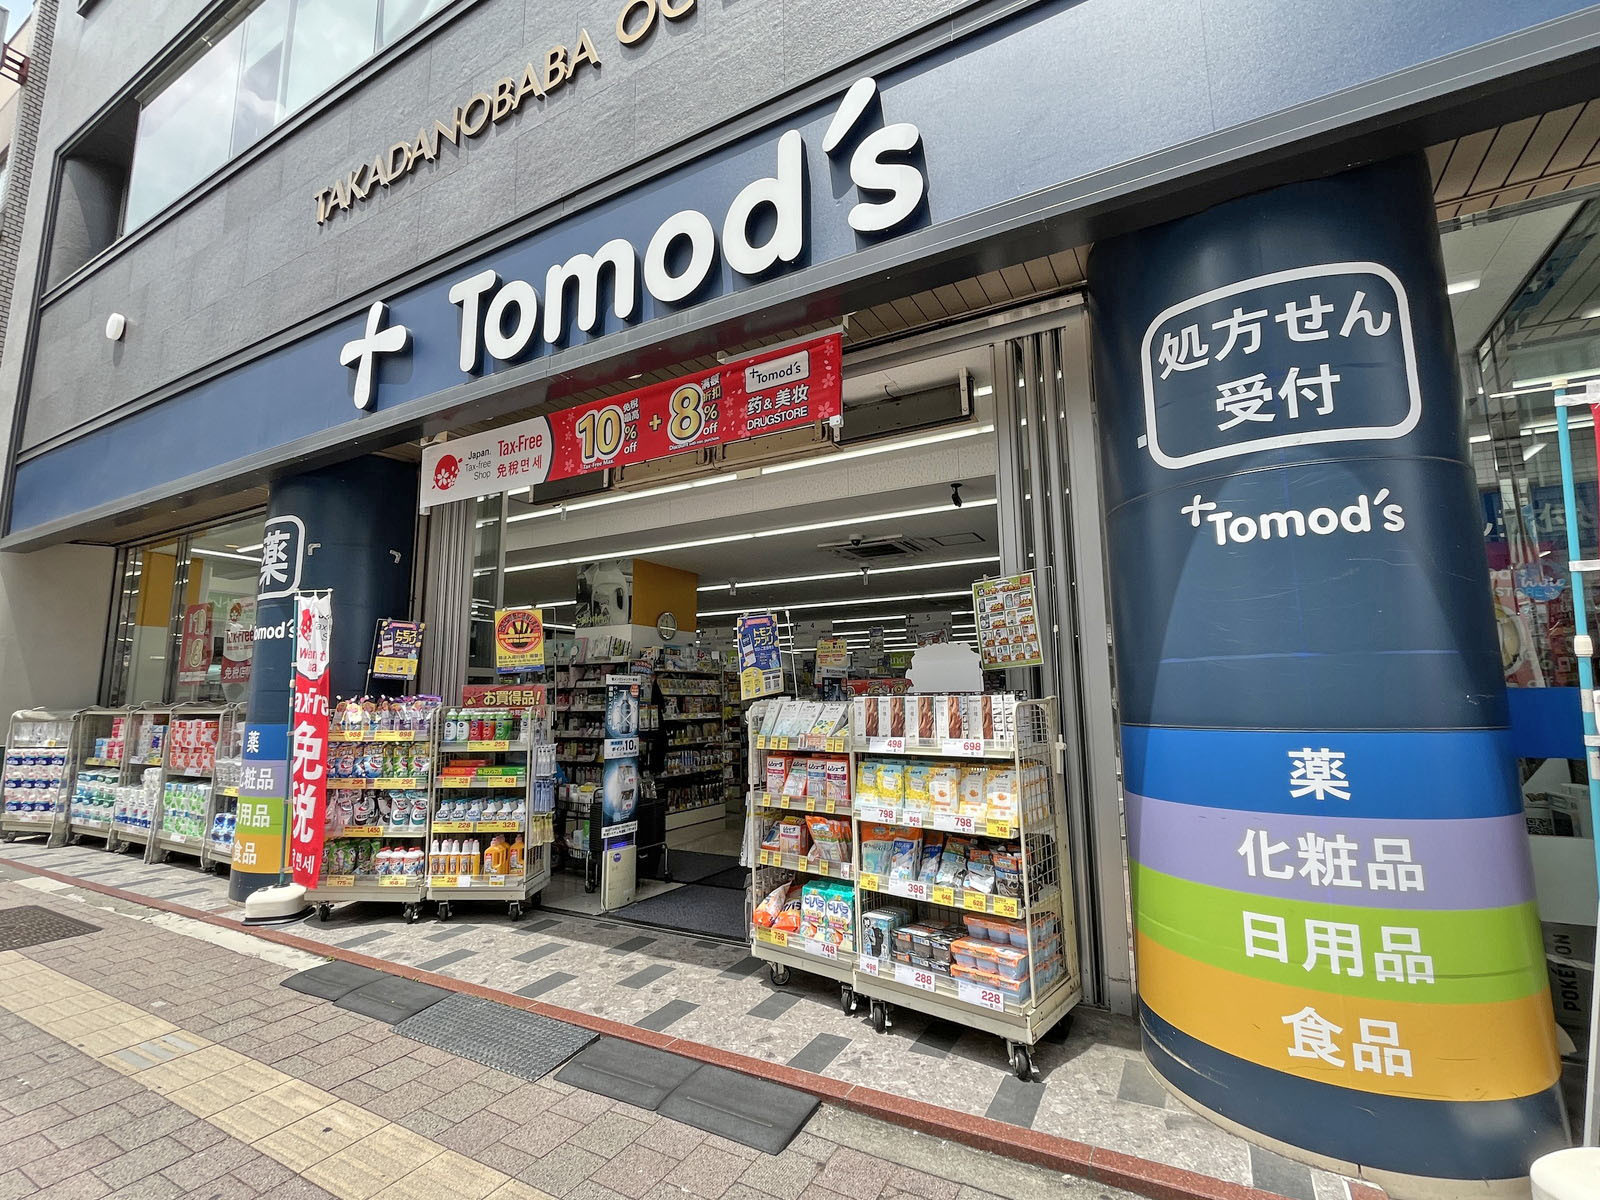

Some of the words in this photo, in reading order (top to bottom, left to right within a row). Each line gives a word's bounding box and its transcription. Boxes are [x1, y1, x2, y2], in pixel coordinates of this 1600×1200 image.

[314, 28, 600, 225] TAKADANOBABA
[449, 76, 925, 375] Tomod's
[1158, 290, 1392, 380] 処方せん
[756, 364, 801, 384] Tomod's
[1215, 363, 1341, 431] 受付
[575, 405, 625, 464] 10
[623, 441, 638, 454] off
[667, 382, 705, 446] 8
[703, 421, 719, 436] off
[747, 406, 809, 431] DRUGSTORE
[498, 434, 542, 457] Tax-Free
[465, 460, 492, 472] Tax-free
[474, 470, 491, 480] Shop
[1207, 488, 1406, 546] Tomod's
[483, 690, 541, 706] お買得品!
[246, 731, 260, 753] 薬
[887, 740, 902, 749] 498
[963, 742, 981, 751] 698
[1288, 747, 1352, 800] 薬
[878, 809, 894, 819] 798
[954, 817, 972, 828] 798
[1237, 829, 1425, 892] 化粧品
[907, 883, 925, 895] 398
[821, 943, 835, 954] 748
[1242, 911, 1436, 984] 日用品
[915, 972, 932, 985] 288
[981, 990, 1001, 1004] 228
[1281, 1006, 1414, 1078] 食品
